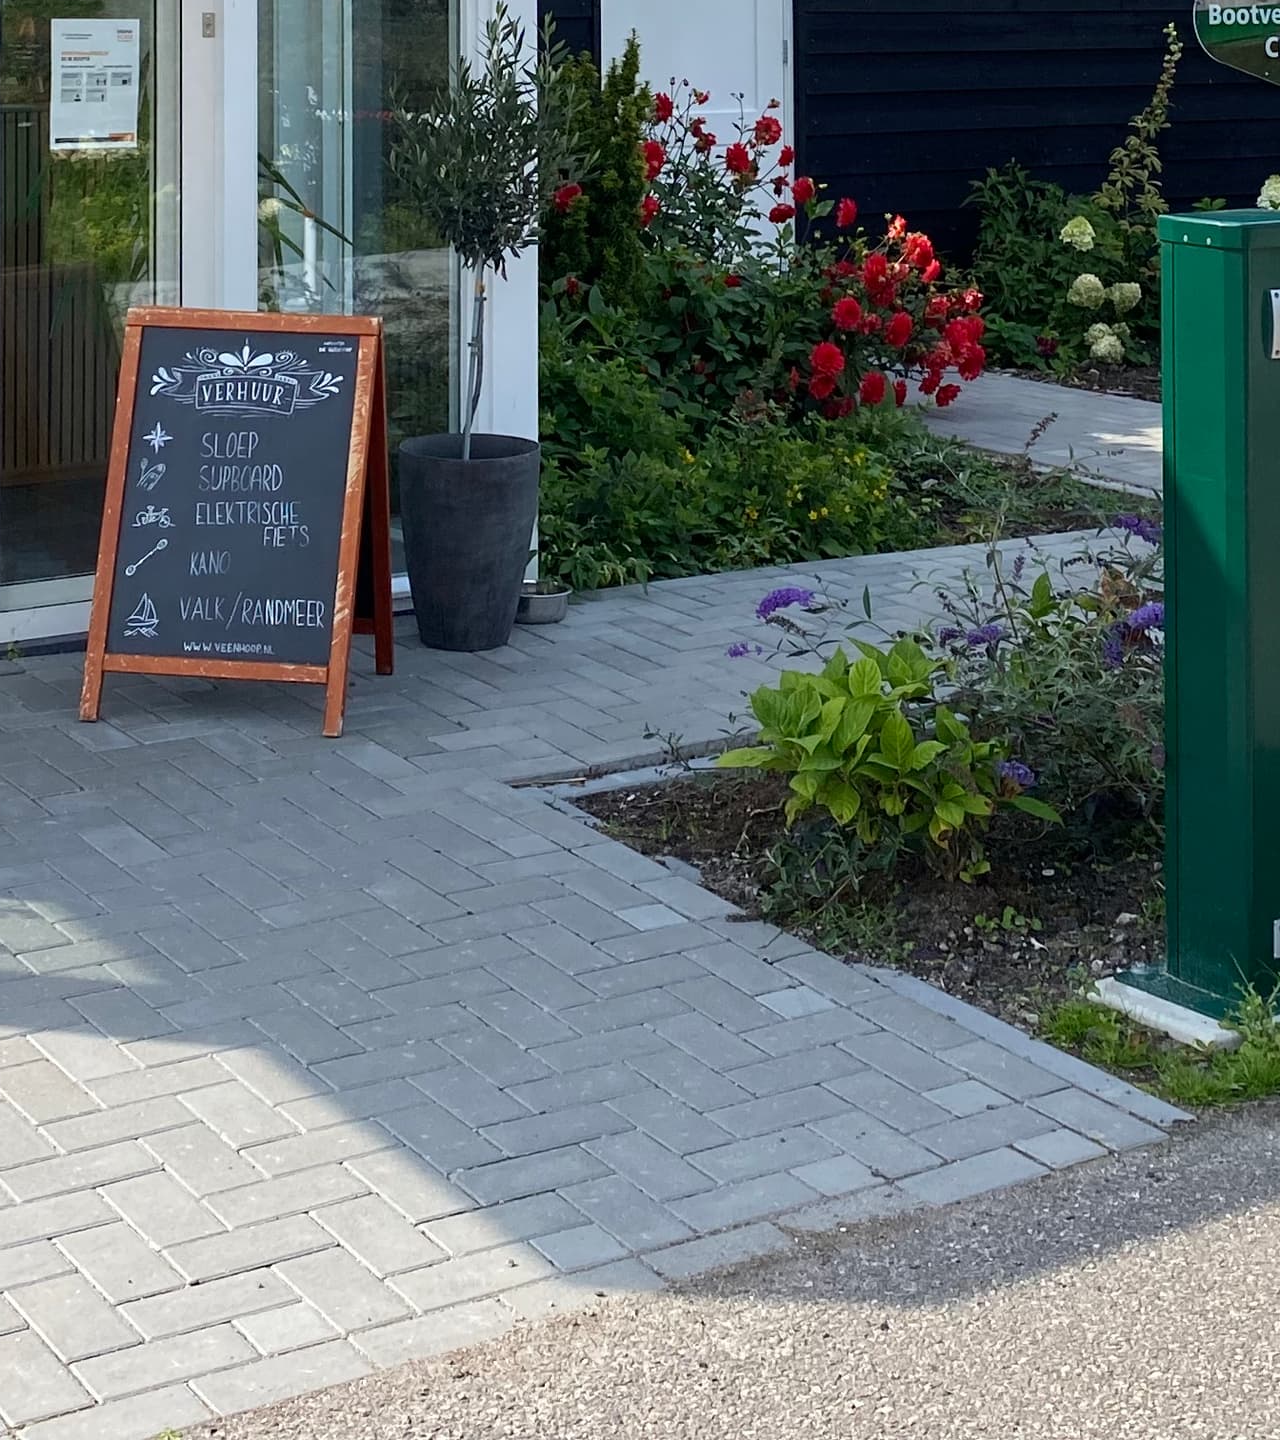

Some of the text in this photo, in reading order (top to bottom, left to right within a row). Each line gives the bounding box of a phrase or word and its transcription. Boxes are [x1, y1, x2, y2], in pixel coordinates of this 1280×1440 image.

[202, 381, 285, 406] VERHUUR
[200, 431, 260, 459] SLOEP
[195, 500, 301, 526] ELEKTRISCHE
[263, 525, 310, 548] FIETS
[189, 550, 232, 576] KANO
